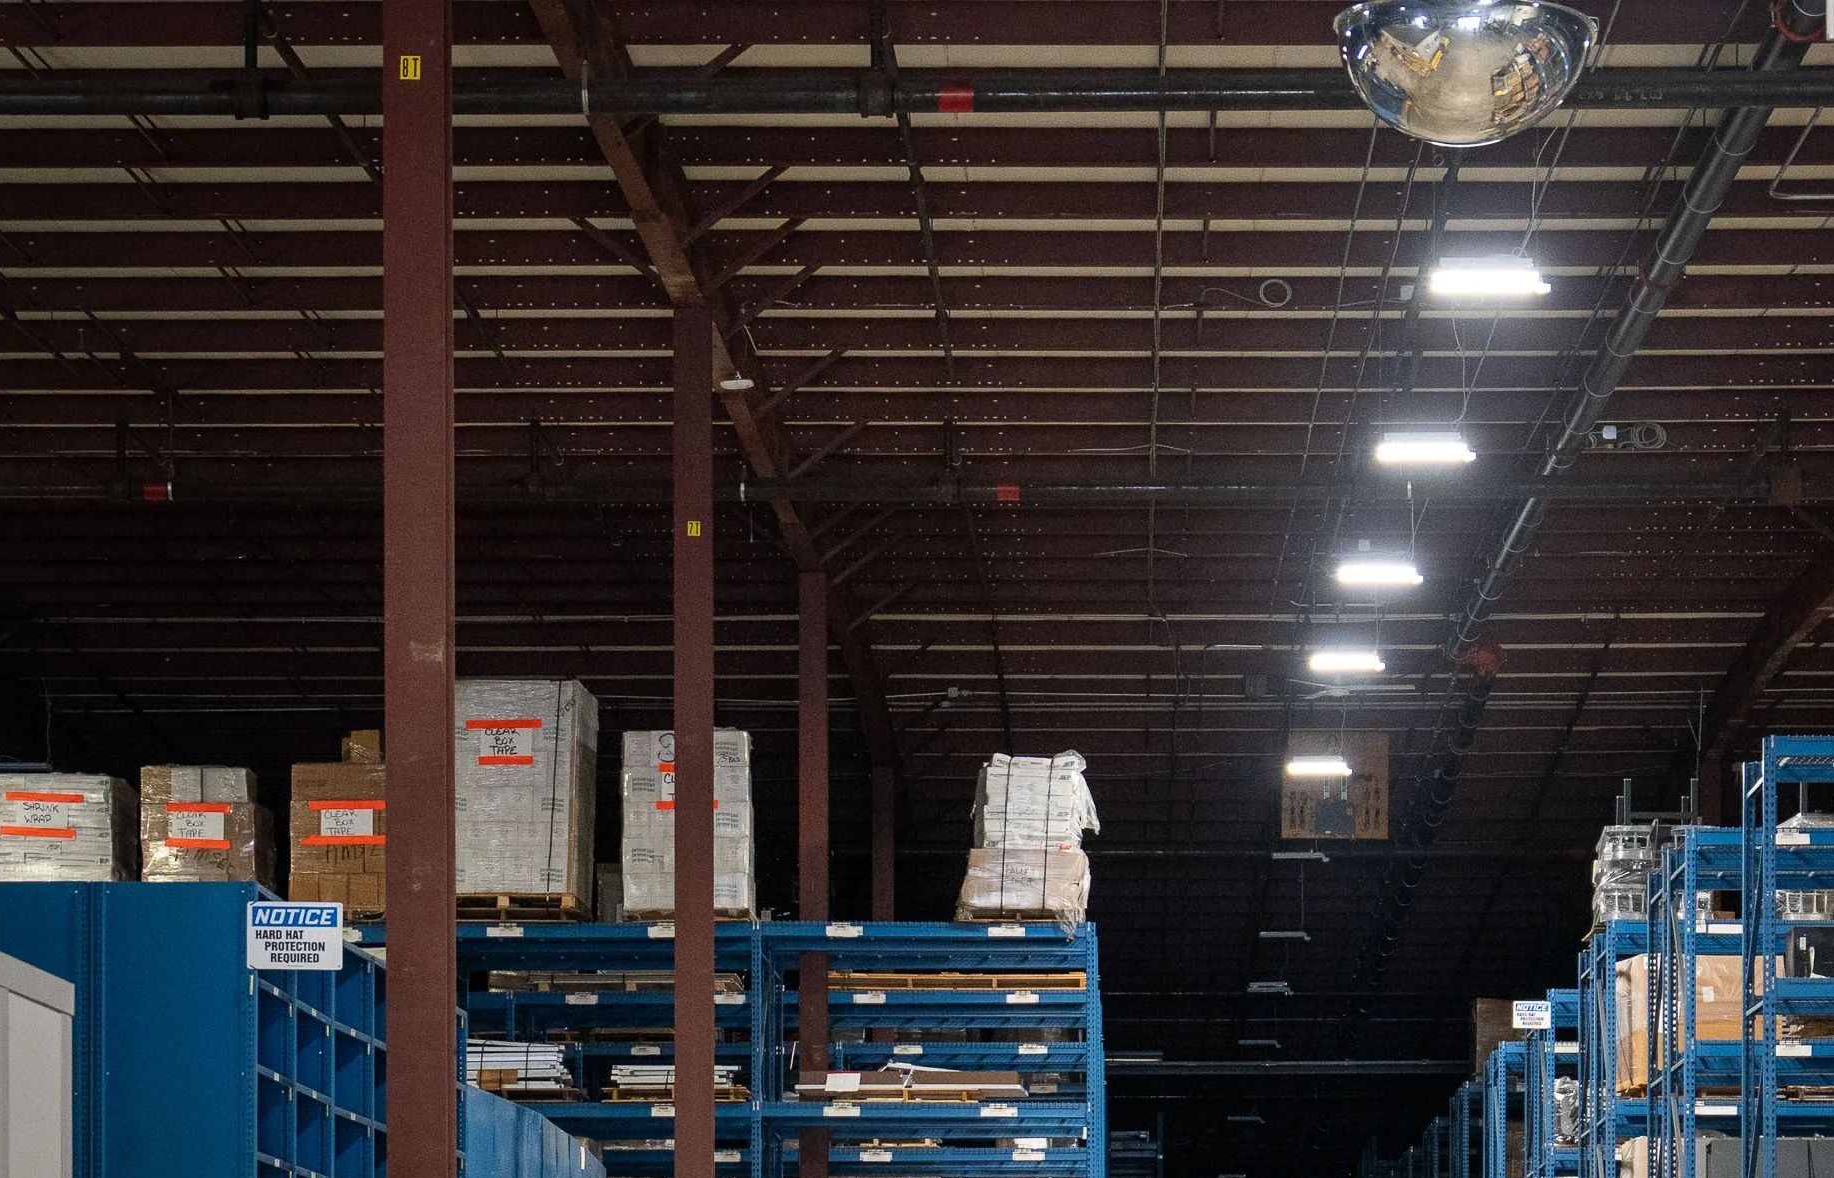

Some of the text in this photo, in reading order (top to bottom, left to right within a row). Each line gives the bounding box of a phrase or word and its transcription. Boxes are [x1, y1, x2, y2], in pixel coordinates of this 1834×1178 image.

[484, 727, 521, 736] CLEAR
[494, 736, 515, 745] BOX
[489, 745, 518, 755] TAPE
[23, 802, 60, 813] SHRINK
[324, 809, 358, 818] CLEAR
[23, 814, 52, 824] WRAP
[186, 820, 205, 828] BOX
[334, 818, 354, 826] BOX
[176, 828, 205, 838] TAPE
[325, 827, 352, 836] TAPE
[254, 908, 335, 925] NOTICE
[255, 929, 304, 940] HARD HAT
[265, 941, 325, 952] PROTECTION
[270, 953, 320, 963] REQUIRED
[1516, 1003, 1548, 1011] NOTICE
